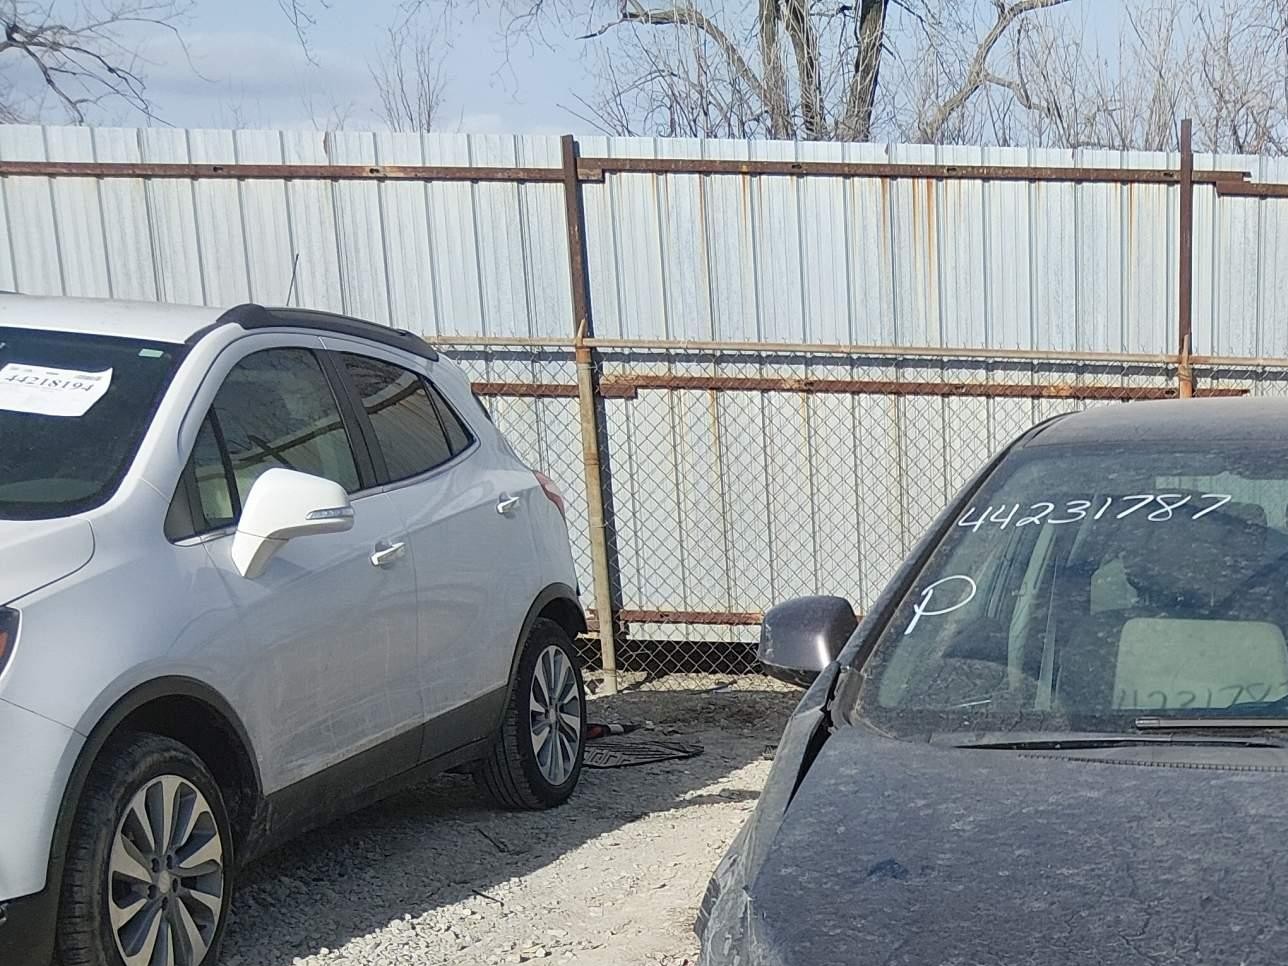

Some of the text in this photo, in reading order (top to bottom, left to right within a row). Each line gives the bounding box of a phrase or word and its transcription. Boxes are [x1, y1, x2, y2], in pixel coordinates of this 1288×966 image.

[5, 373, 95, 392] 44218194
[957, 494, 1232, 532] 44231787
[904, 575, 977, 634] P
